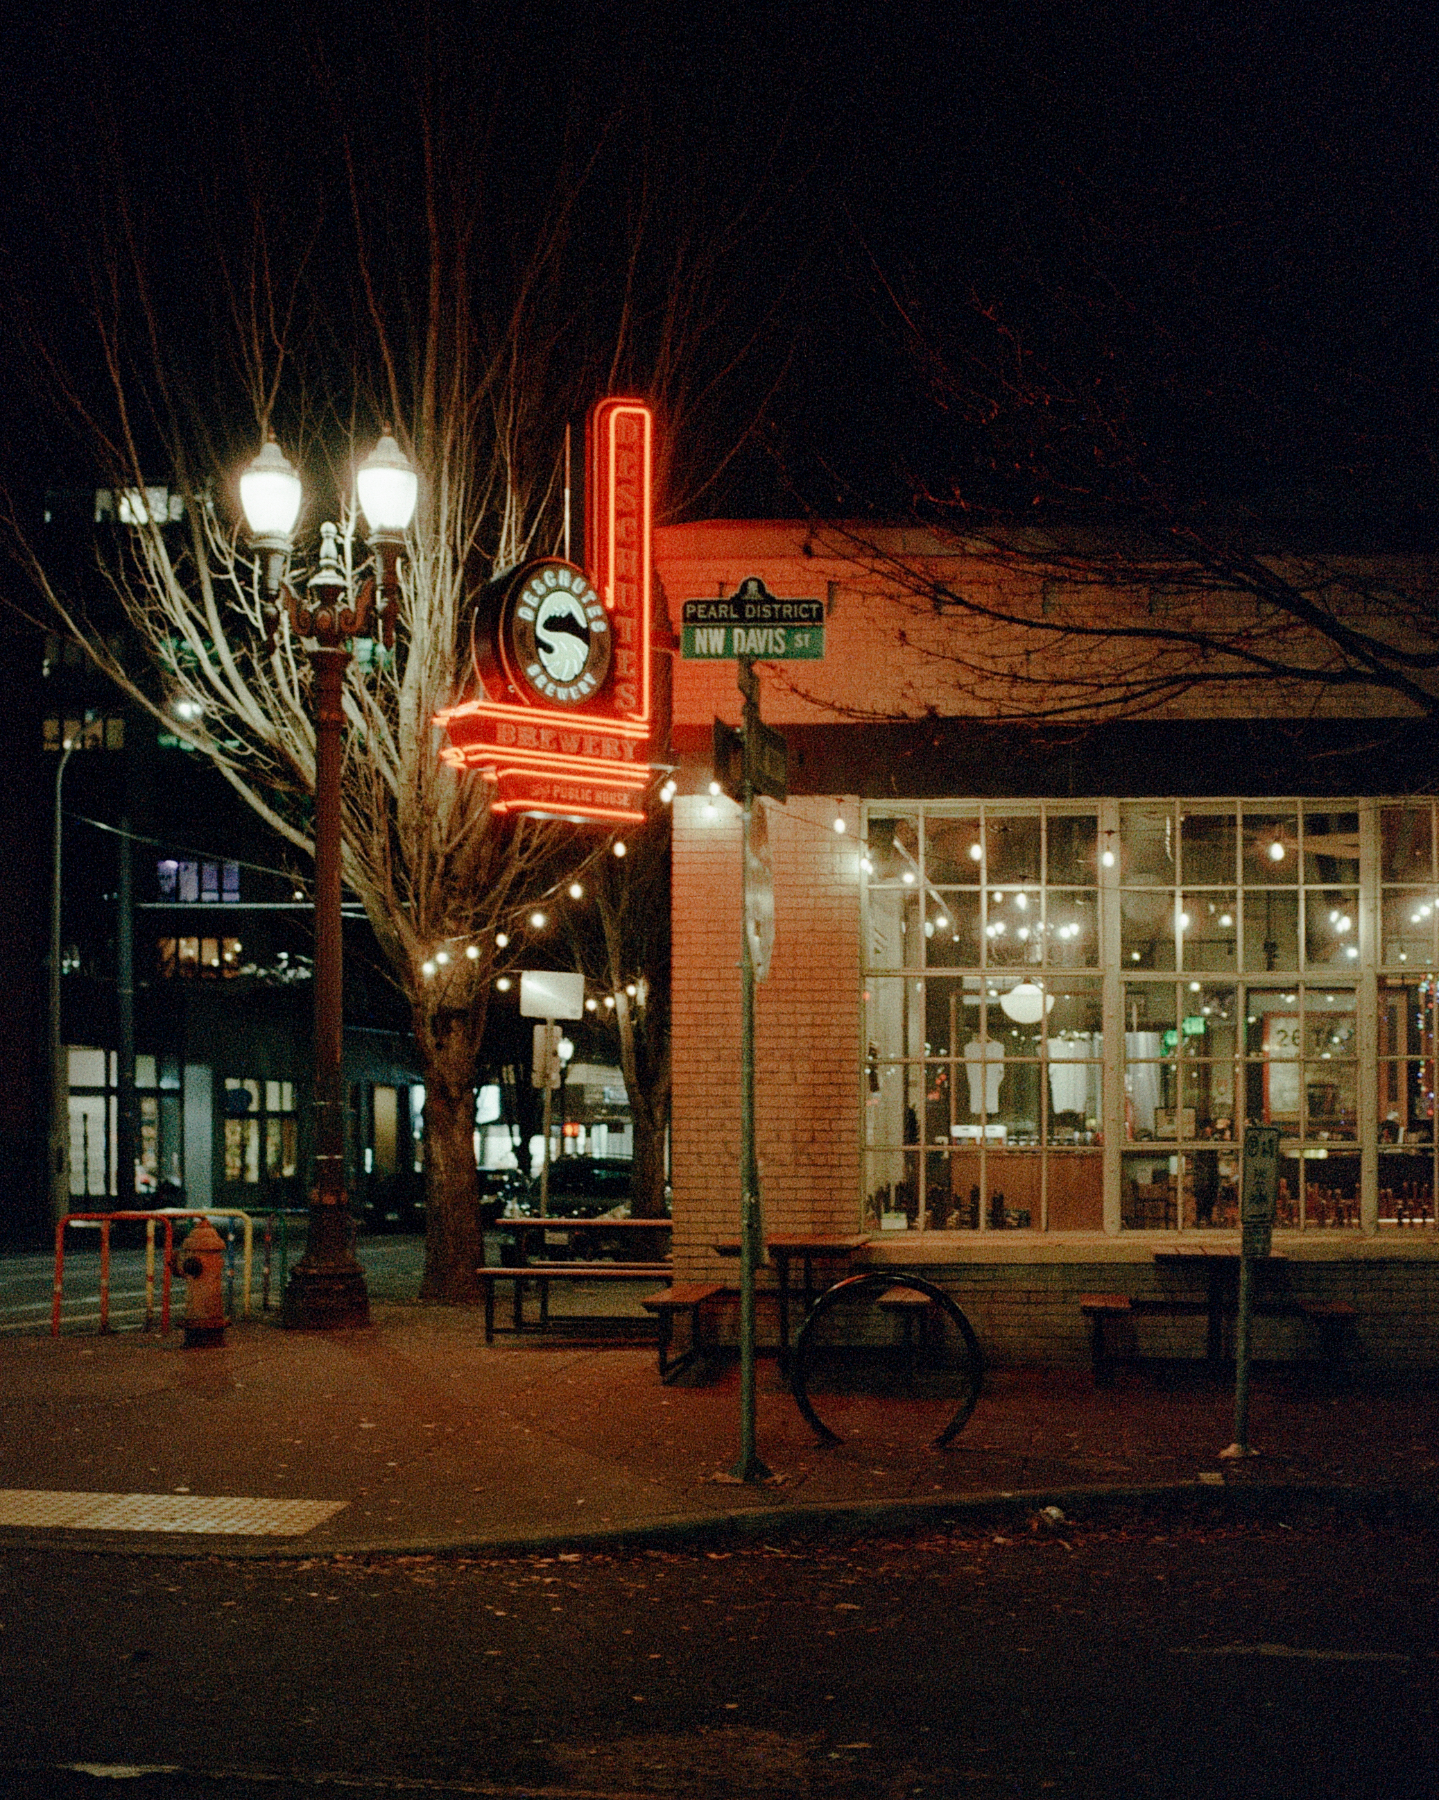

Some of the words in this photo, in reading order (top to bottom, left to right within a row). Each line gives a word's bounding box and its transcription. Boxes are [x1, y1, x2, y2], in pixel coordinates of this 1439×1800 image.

[518, 569, 607, 633] DESCHUTES
[686, 604, 739, 619] PEARL
[745, 603, 820, 619] DISTRICT
[694, 627, 725, 654] NW
[732, 627, 786, 654] DAVIS
[793, 633, 811, 648] ST
[526, 664, 597, 700] BREWERY
[496, 722, 638, 761] BREWERY
[552, 784, 593, 803] PUBLIC
